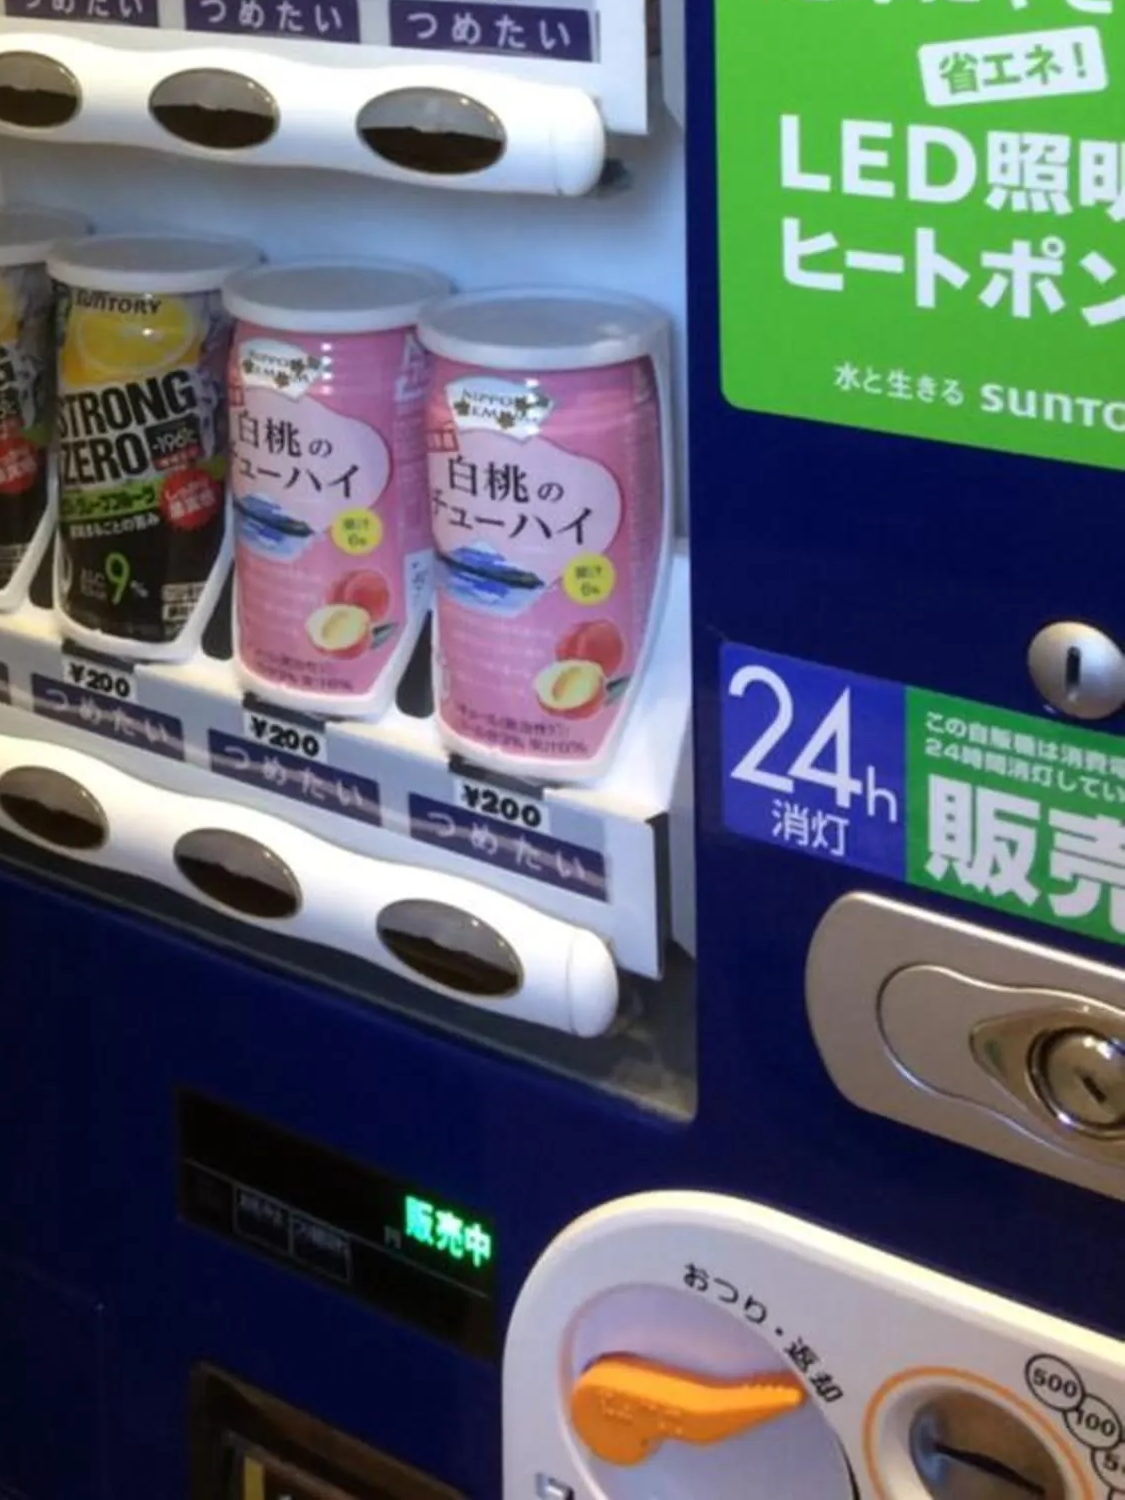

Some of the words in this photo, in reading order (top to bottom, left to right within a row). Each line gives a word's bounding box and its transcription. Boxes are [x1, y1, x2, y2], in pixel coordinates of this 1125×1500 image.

[406, 10, 573, 51] つめたい
[938, 41, 1088, 97] 省エネ!
[834, 360, 965, 407] 水と生きる
[237, 409, 334, 458] 白桃の
[60, 432, 150, 486] ZERO
[447, 455, 565, 504] 白桃の
[69, 663, 131, 699] ¥200
[44, 689, 171, 743] つめたい
[251, 715, 321, 758] ¥200
[224, 745, 363, 808] つめたい
[461, 784, 543, 829] ¥200
[771, 798, 850, 857] 消灯
[427, 810, 587, 879] つめたい
[923, 773, 1125, 935] 販売
[404, 1194, 492, 1268] 販売中
[682, 1261, 845, 1406] おつり・返却
[1032, 1367, 1078, 1399] 500
[1075, 1408, 1117, 1438] 100
[1103, 1451, 1125, 1477] 5
